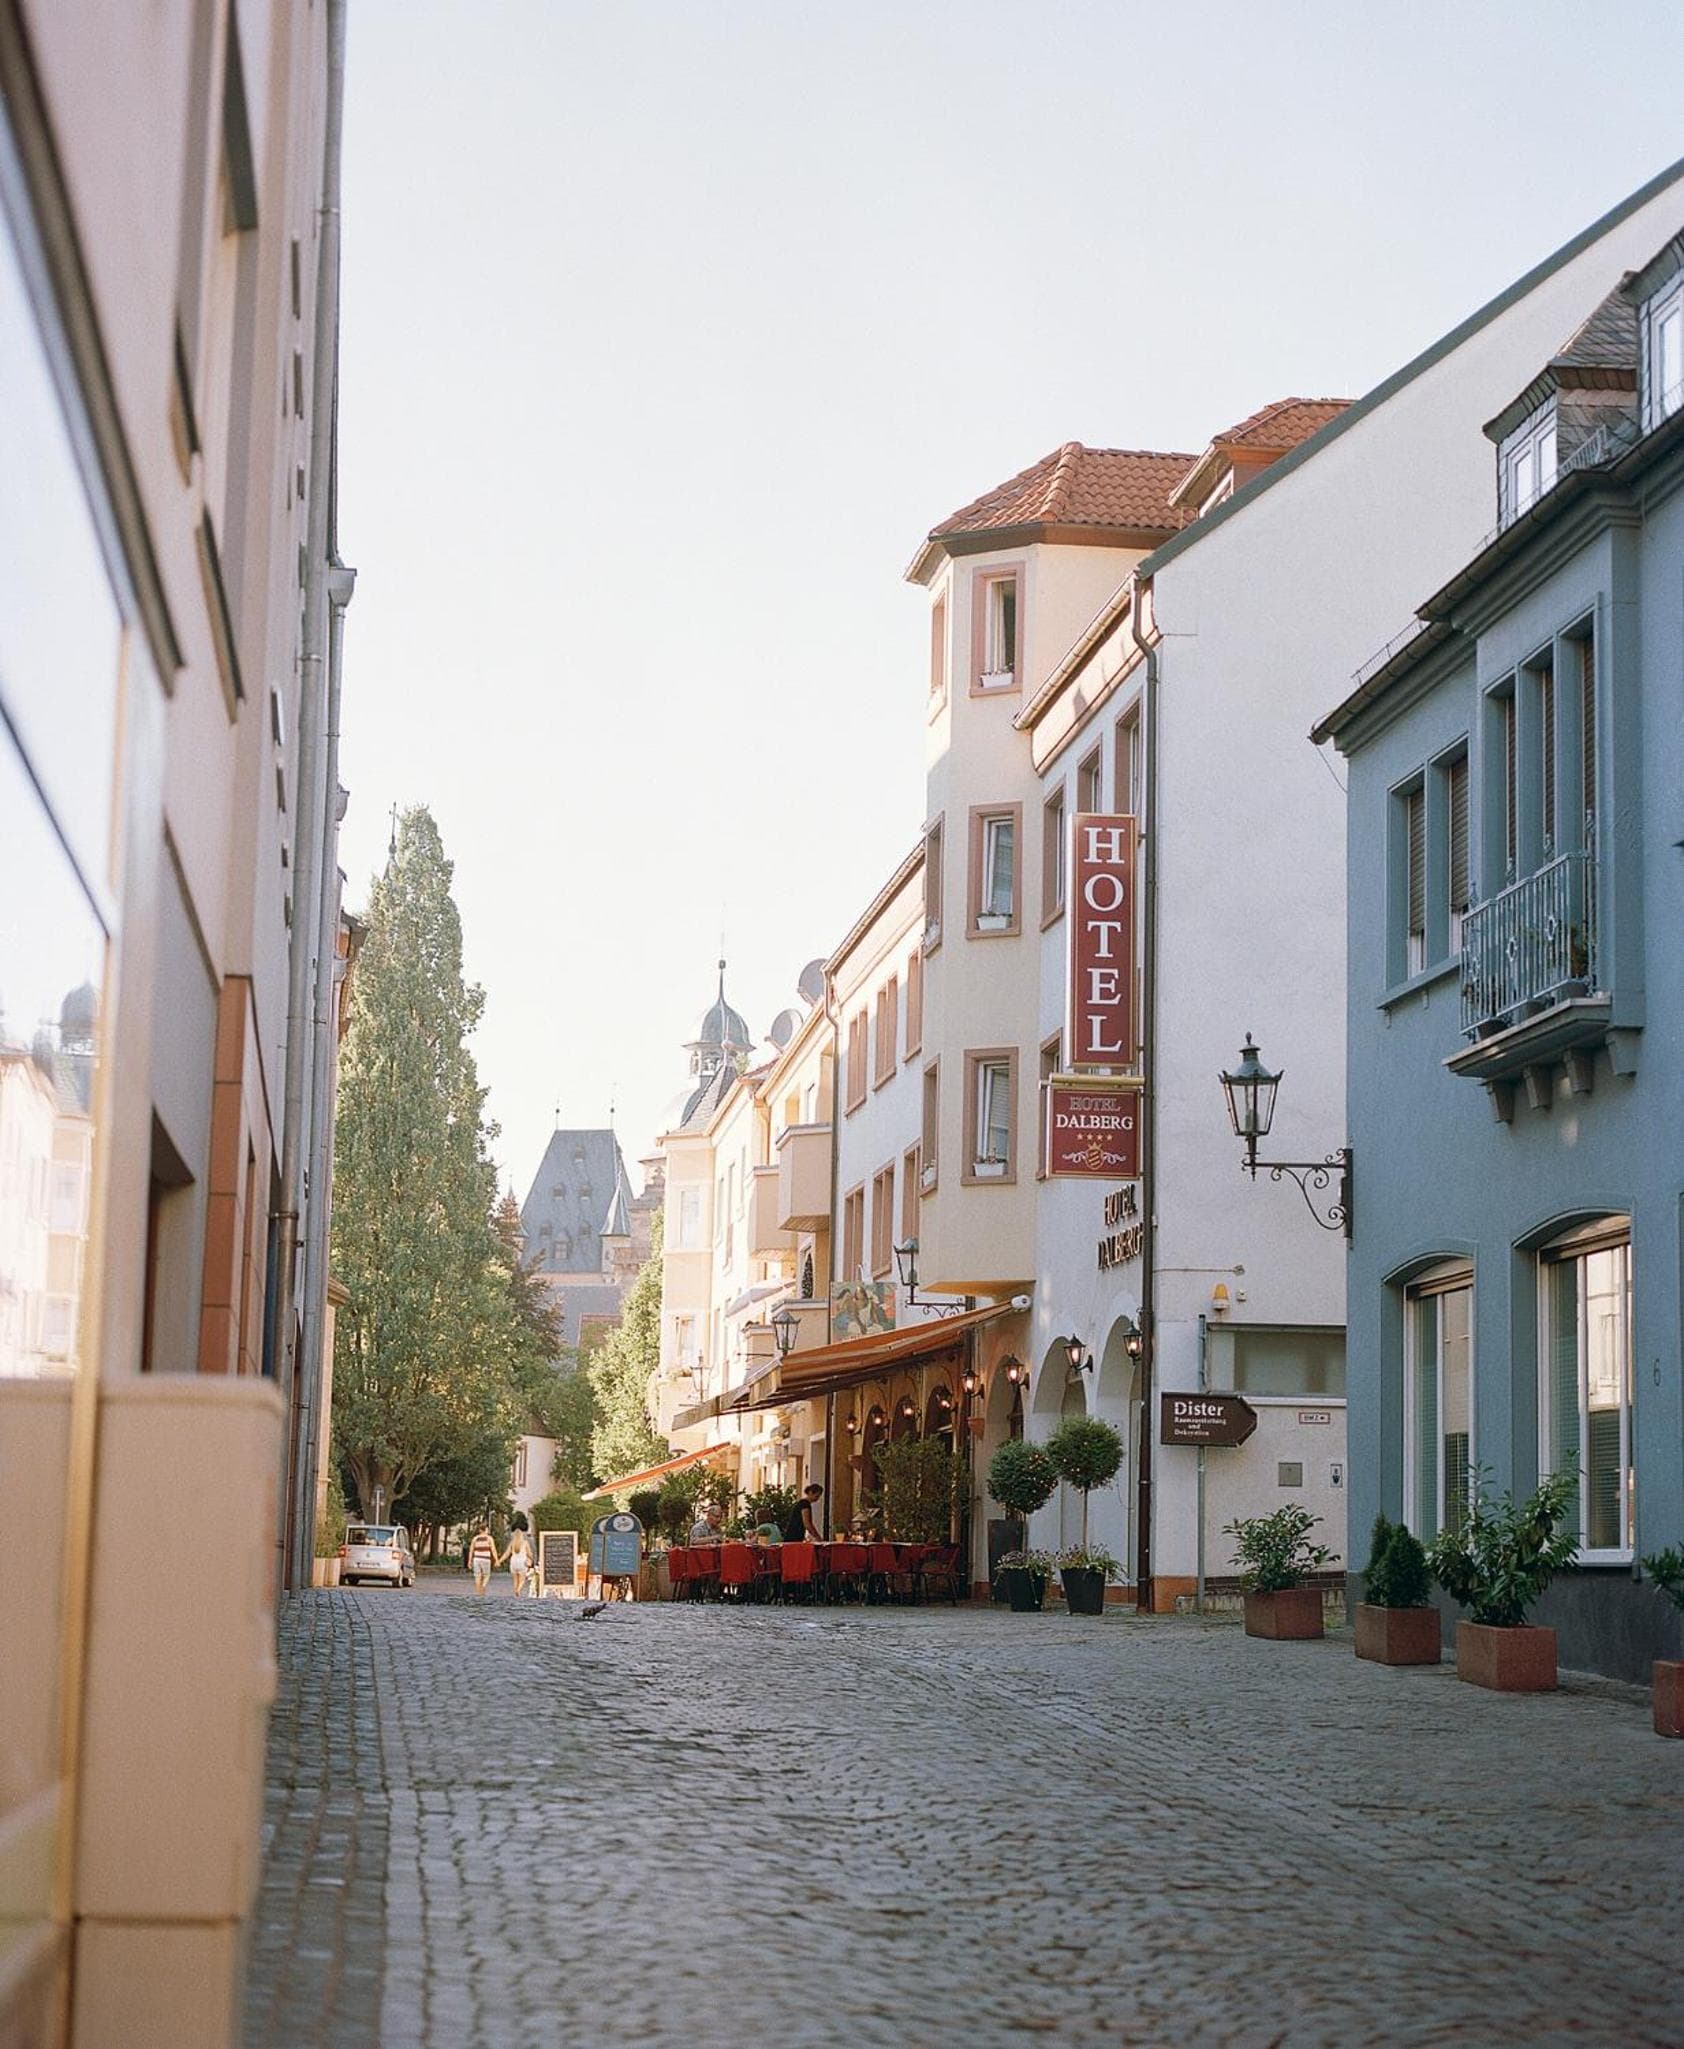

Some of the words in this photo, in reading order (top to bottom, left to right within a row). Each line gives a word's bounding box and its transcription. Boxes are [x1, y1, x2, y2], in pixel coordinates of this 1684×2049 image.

[1083, 827, 1125, 1052] HOTEL
[1070, 1096, 1120, 1111] HOTEL
[1056, 1113, 1133, 1130] DALBERG
[1104, 1184, 1137, 1226] HOTEL
[1653, 1358, 1661, 1387] 6
[1174, 1401, 1224, 1416] Dister
